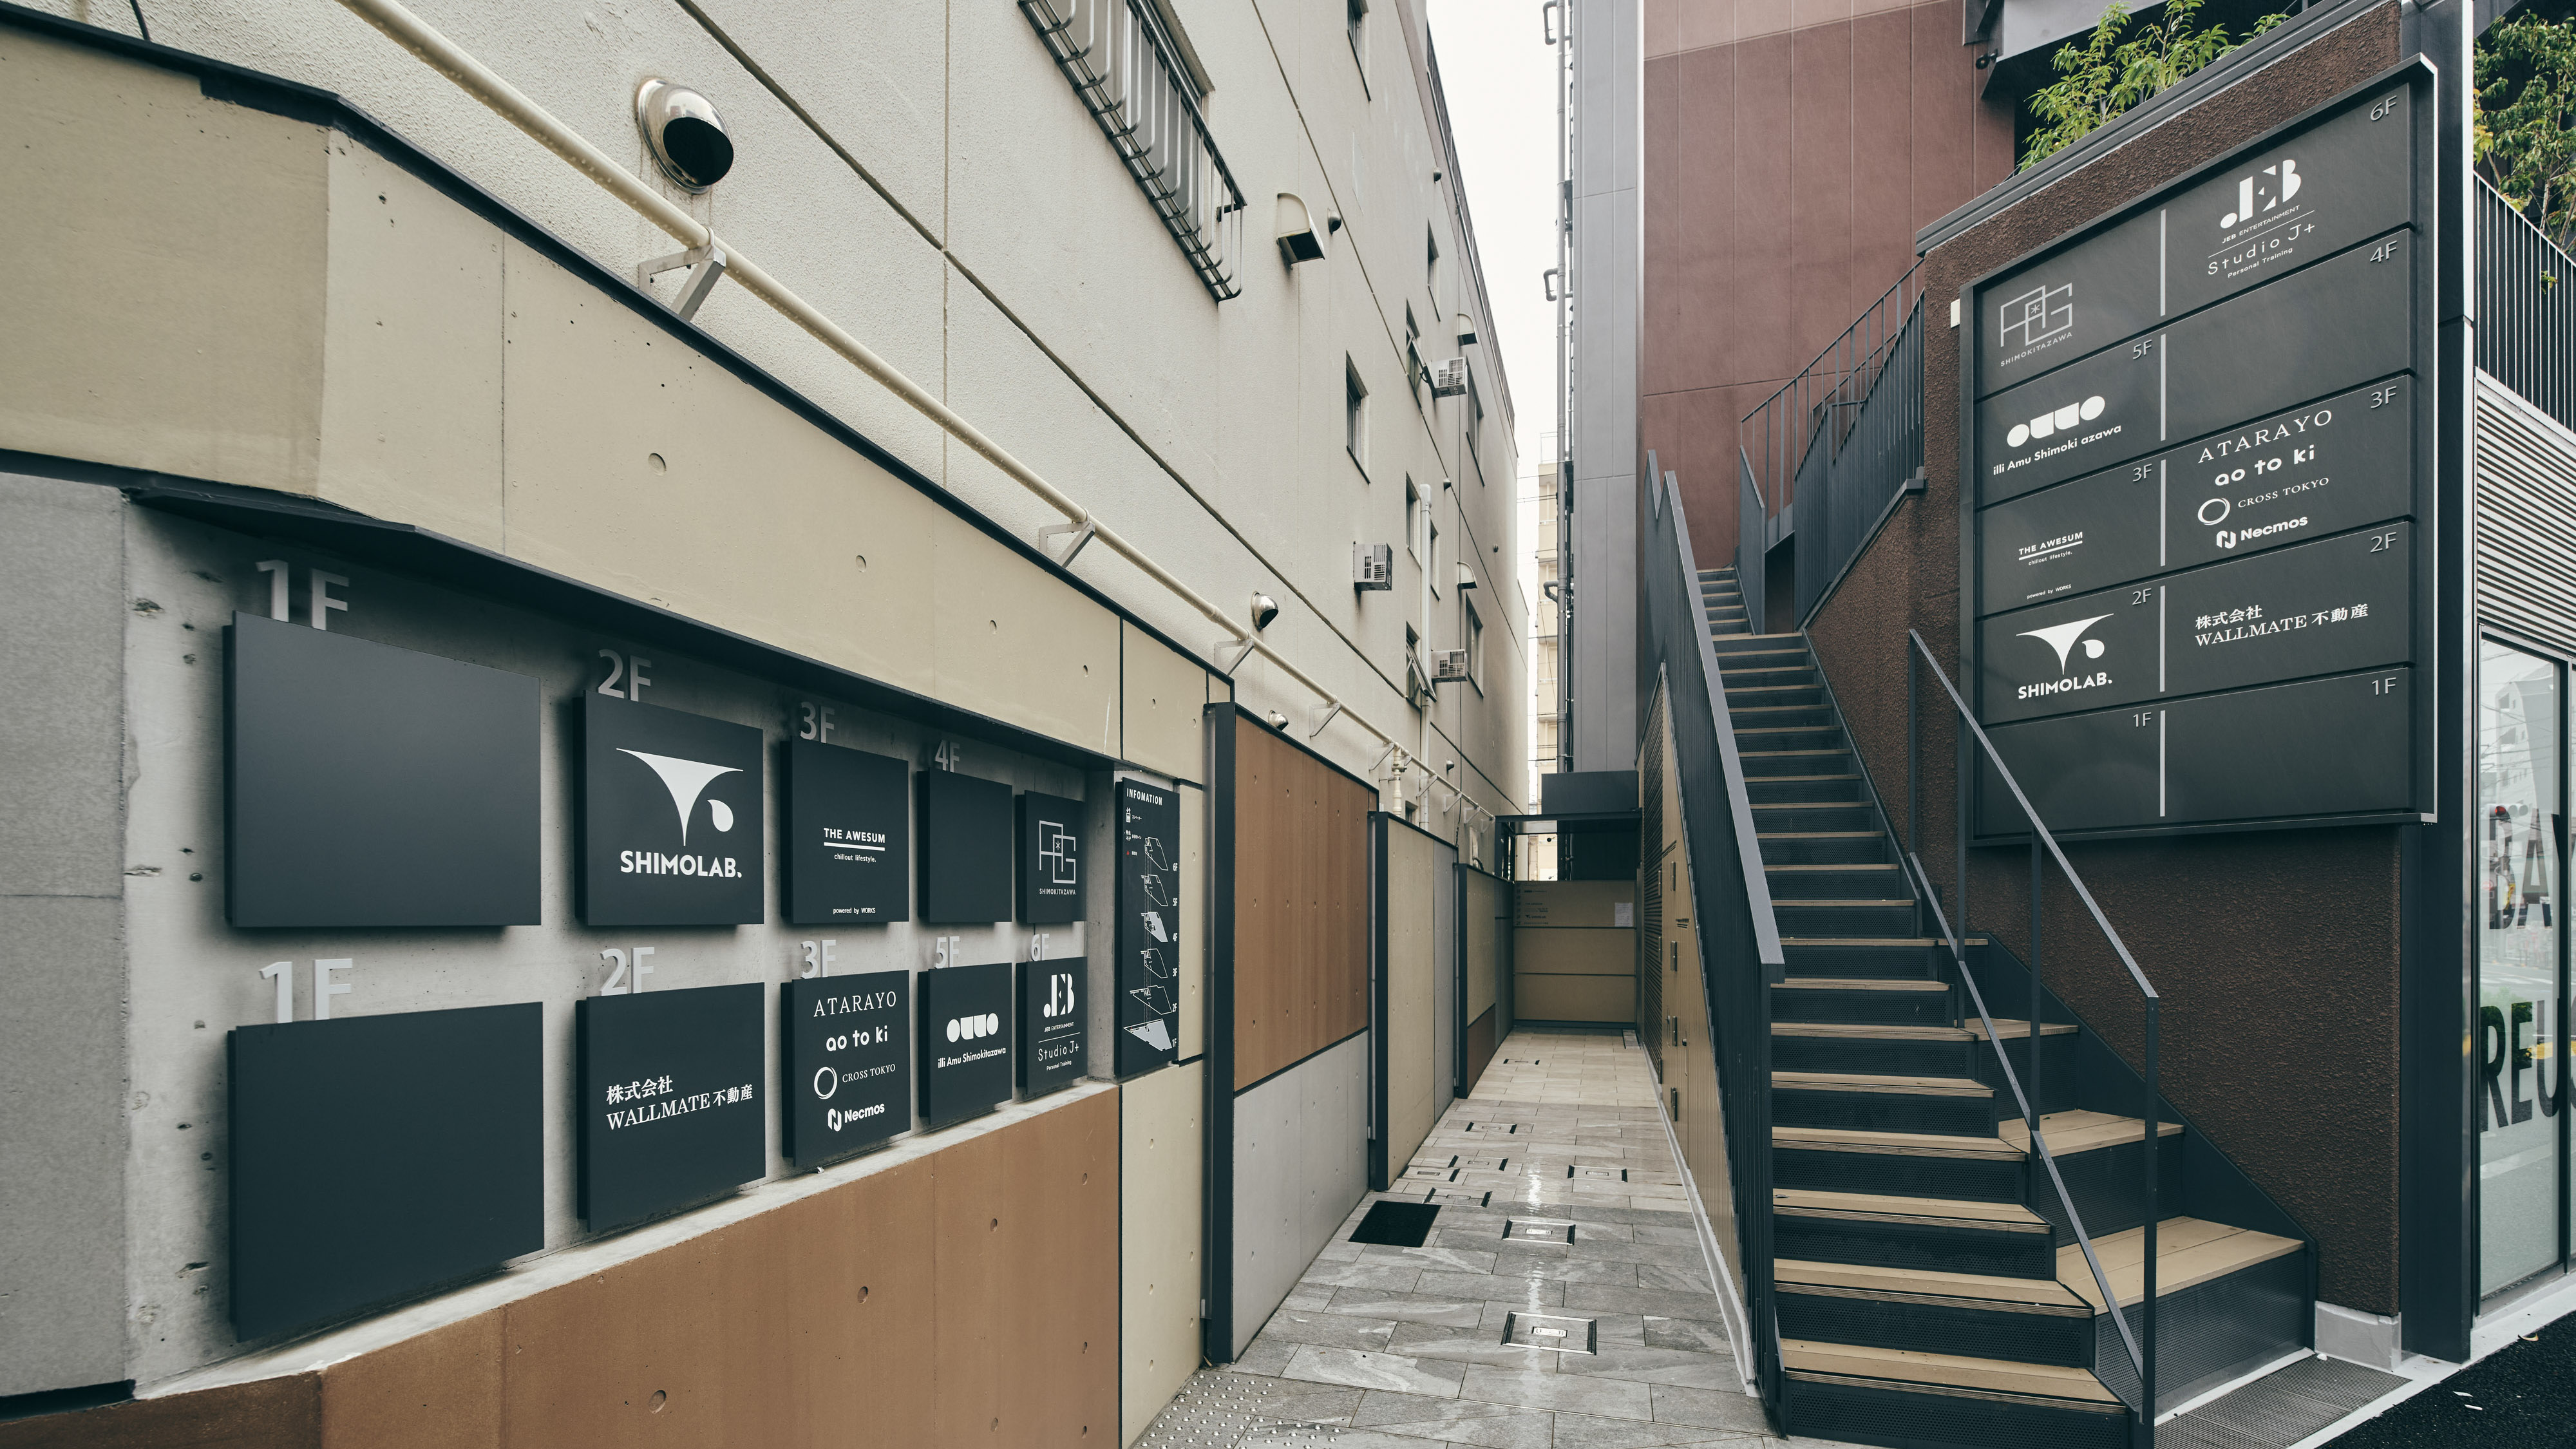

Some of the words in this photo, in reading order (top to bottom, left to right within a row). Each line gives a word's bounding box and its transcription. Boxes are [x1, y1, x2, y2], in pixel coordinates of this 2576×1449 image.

[2371, 95, 2396, 120] 6F
[2222, 233, 2237, 243] JEB
[2239, 205, 2300, 236] ENTERTAINMENT
[2208, 238, 2280, 275] Studio
[2288, 223, 2315, 241] J+
[2370, 240, 2397, 261] 4F
[2228, 261, 2259, 278] Personal
[2262, 248, 2292, 263] Training
[2000, 332, 2073, 366] SHIMOKITAZAWA
[2133, 339, 2152, 359] 5F
[2371, 386, 2396, 408] 3F
[2198, 410, 2332, 464] ATARAYO
[1993, 463, 2005, 475] illi
[2007, 457, 2031, 470] Amu
[2132, 462, 2152, 481] 3F
[2215, 469, 2245, 486] ao
[2255, 459, 2282, 475] to
[2294, 444, 2314, 464] ki
[2239, 491, 2278, 507] CROSS
[2283, 478, 2329, 495] TOKYO
[2241, 517, 2307, 540] Necmos
[2018, 544, 2036, 555] THE
[2040, 532, 2082, 549] AWESUM
[2371, 532, 2396, 552] 2F
[2028, 557, 2047, 565] chillout
[2049, 550, 2073, 560] lifestyle.
[256, 559, 349, 631] 1F
[2027, 590, 2046, 600] powered
[2055, 583, 2072, 592] WORKS
[2132, 588, 2151, 605] 2F
[2195, 605, 2262, 629] 株式会社
[2195, 615, 2306, 646] WALLMATE
[2312, 603, 2368, 625] 不動産
[598, 649, 652, 703] 2F
[2018, 672, 2112, 699] SHIMOLAB.
[2372, 677, 2396, 695] 1F
[800, 701, 835, 743] 3F
[2134, 712, 2151, 726] 1F
[935, 739, 960, 772] 4F
[1127, 788, 1162, 805] INFOMATION
[823, 828, 842, 839] THE
[846, 830, 886, 844] AWESUM
[621, 851, 742, 878] SHIMOLAB.
[834, 853, 853, 861] chillout
[855, 855, 876, 864] lifestyle.
[1173, 862, 1178, 871] 6F
[1173, 897, 1178, 907] 5F
[1030, 933, 1050, 961] 6F
[1172, 933, 1178, 942] 4F
[800, 940, 837, 979] 3F
[935, 936, 960, 969] 5F
[598, 947, 655, 996] 2F
[1172, 967, 1178, 977] 3F
[259, 958, 353, 1023] 1F
[814, 991, 896, 1017] ATARAYO
[1172, 1003, 1177, 1012] 2F
[1051, 1021, 1074, 1031] ENTERTAINMENT
[826, 1036, 847, 1051] ao
[853, 1030, 869, 1046] to
[876, 1025, 887, 1043] ki
[1171, 1037, 1177, 1048] 1F
[946, 1056, 961, 1066] Amu
[963, 1048, 1005, 1063] Shimokitazawa
[1038, 1045, 1066, 1061] Studio
[1069, 1040, 1079, 1054] J+
[842, 1070, 868, 1083] CROSS
[869, 1063, 896, 1077] TOKYO
[1046, 1063, 1060, 1071] Personal
[2480, 995, 2576, 1133] REU
[607, 1075, 673, 1104] 株式会社
[607, 1093, 710, 1130] WALLMATE
[713, 1084, 752, 1106] 不動産
[845, 1104, 884, 1122] Necmos
